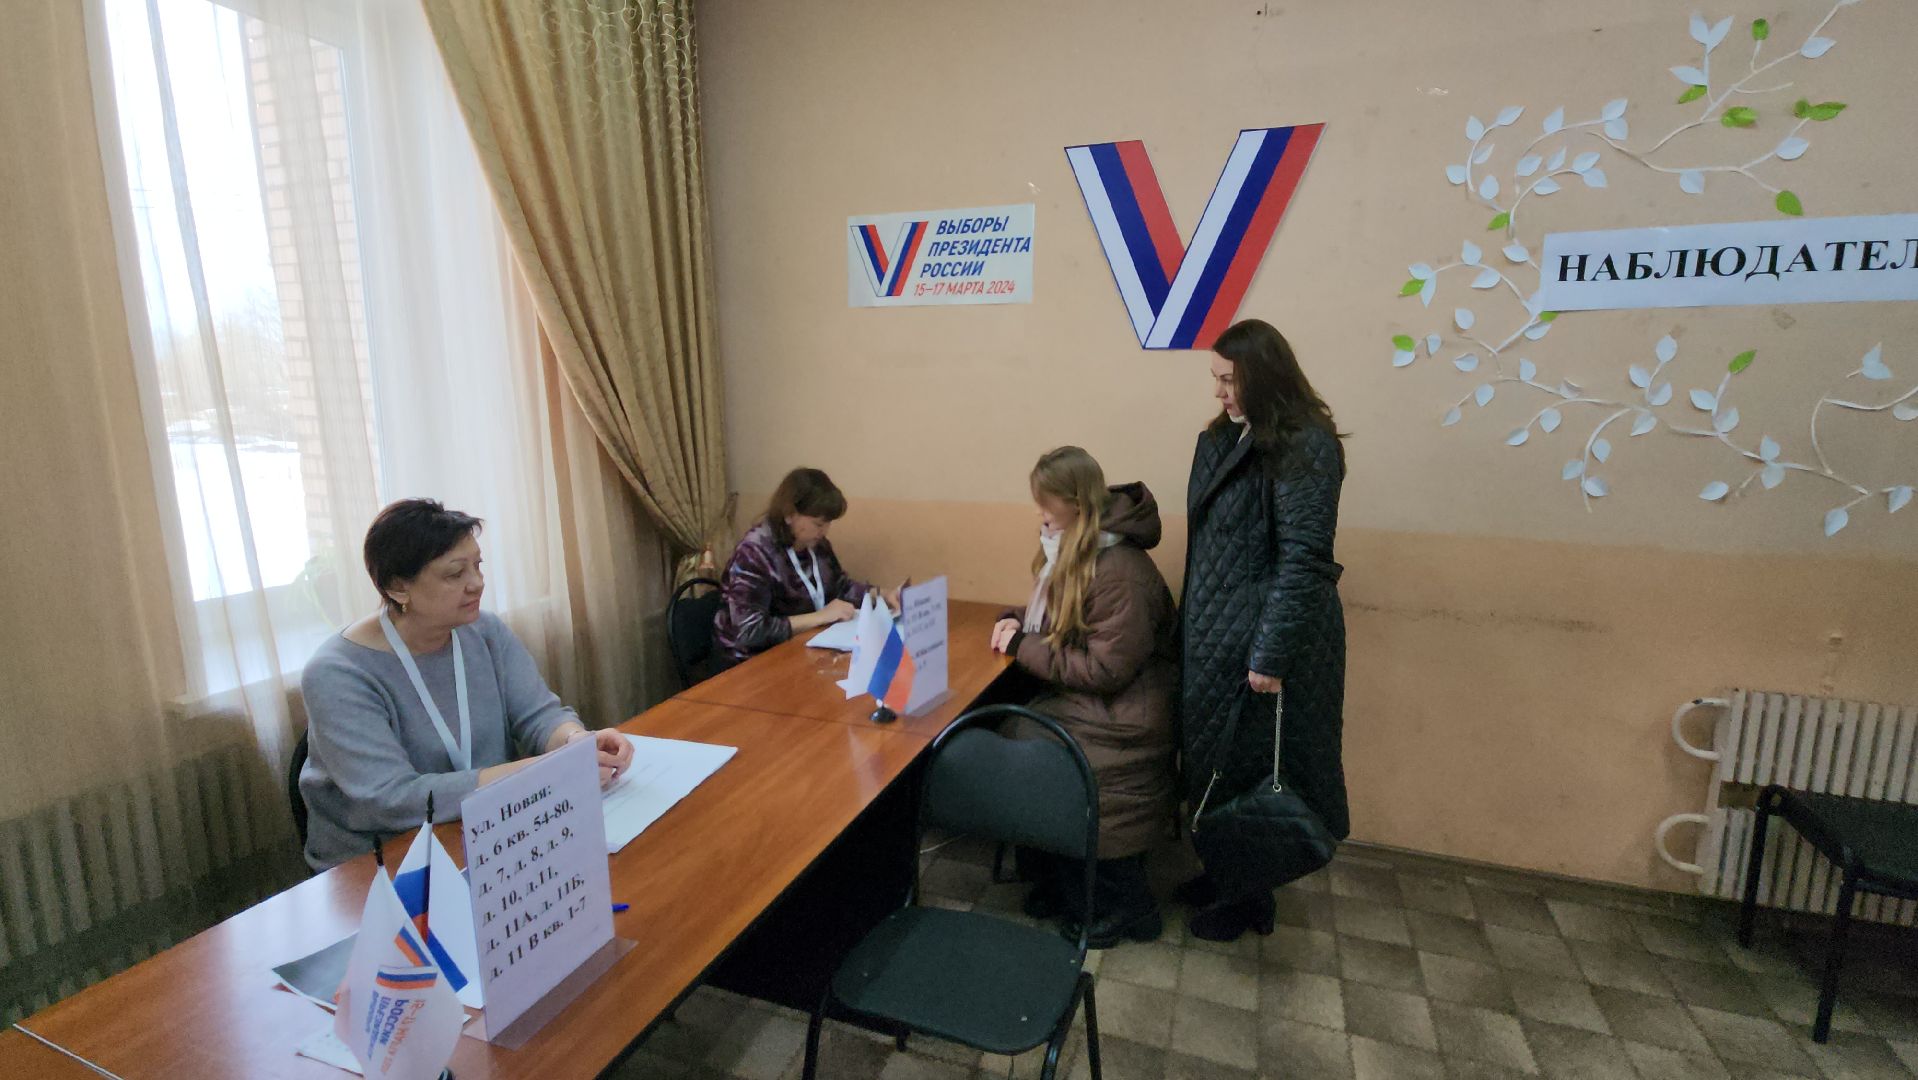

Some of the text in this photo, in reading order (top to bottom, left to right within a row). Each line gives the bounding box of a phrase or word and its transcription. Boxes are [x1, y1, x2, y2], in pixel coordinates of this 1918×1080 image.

[936, 216, 1010, 235] ВЫБОРЫ
[928, 237, 1032, 257] ПРЕЗИДЕНТА
[920, 260, 985, 278] РОССИИ
[1557, 238, 1918, 283] НАБЛЮДАТЕЛ
[946, 281, 984, 295] МАРТА
[986, 280, 1016, 294] 2024
[471, 784, 551, 844] ул. Новая:
[493, 840, 502, 855] 6
[507, 830, 530, 848] кв.
[508, 944, 522, 965] 11
[543, 921, 564, 939] кв.
